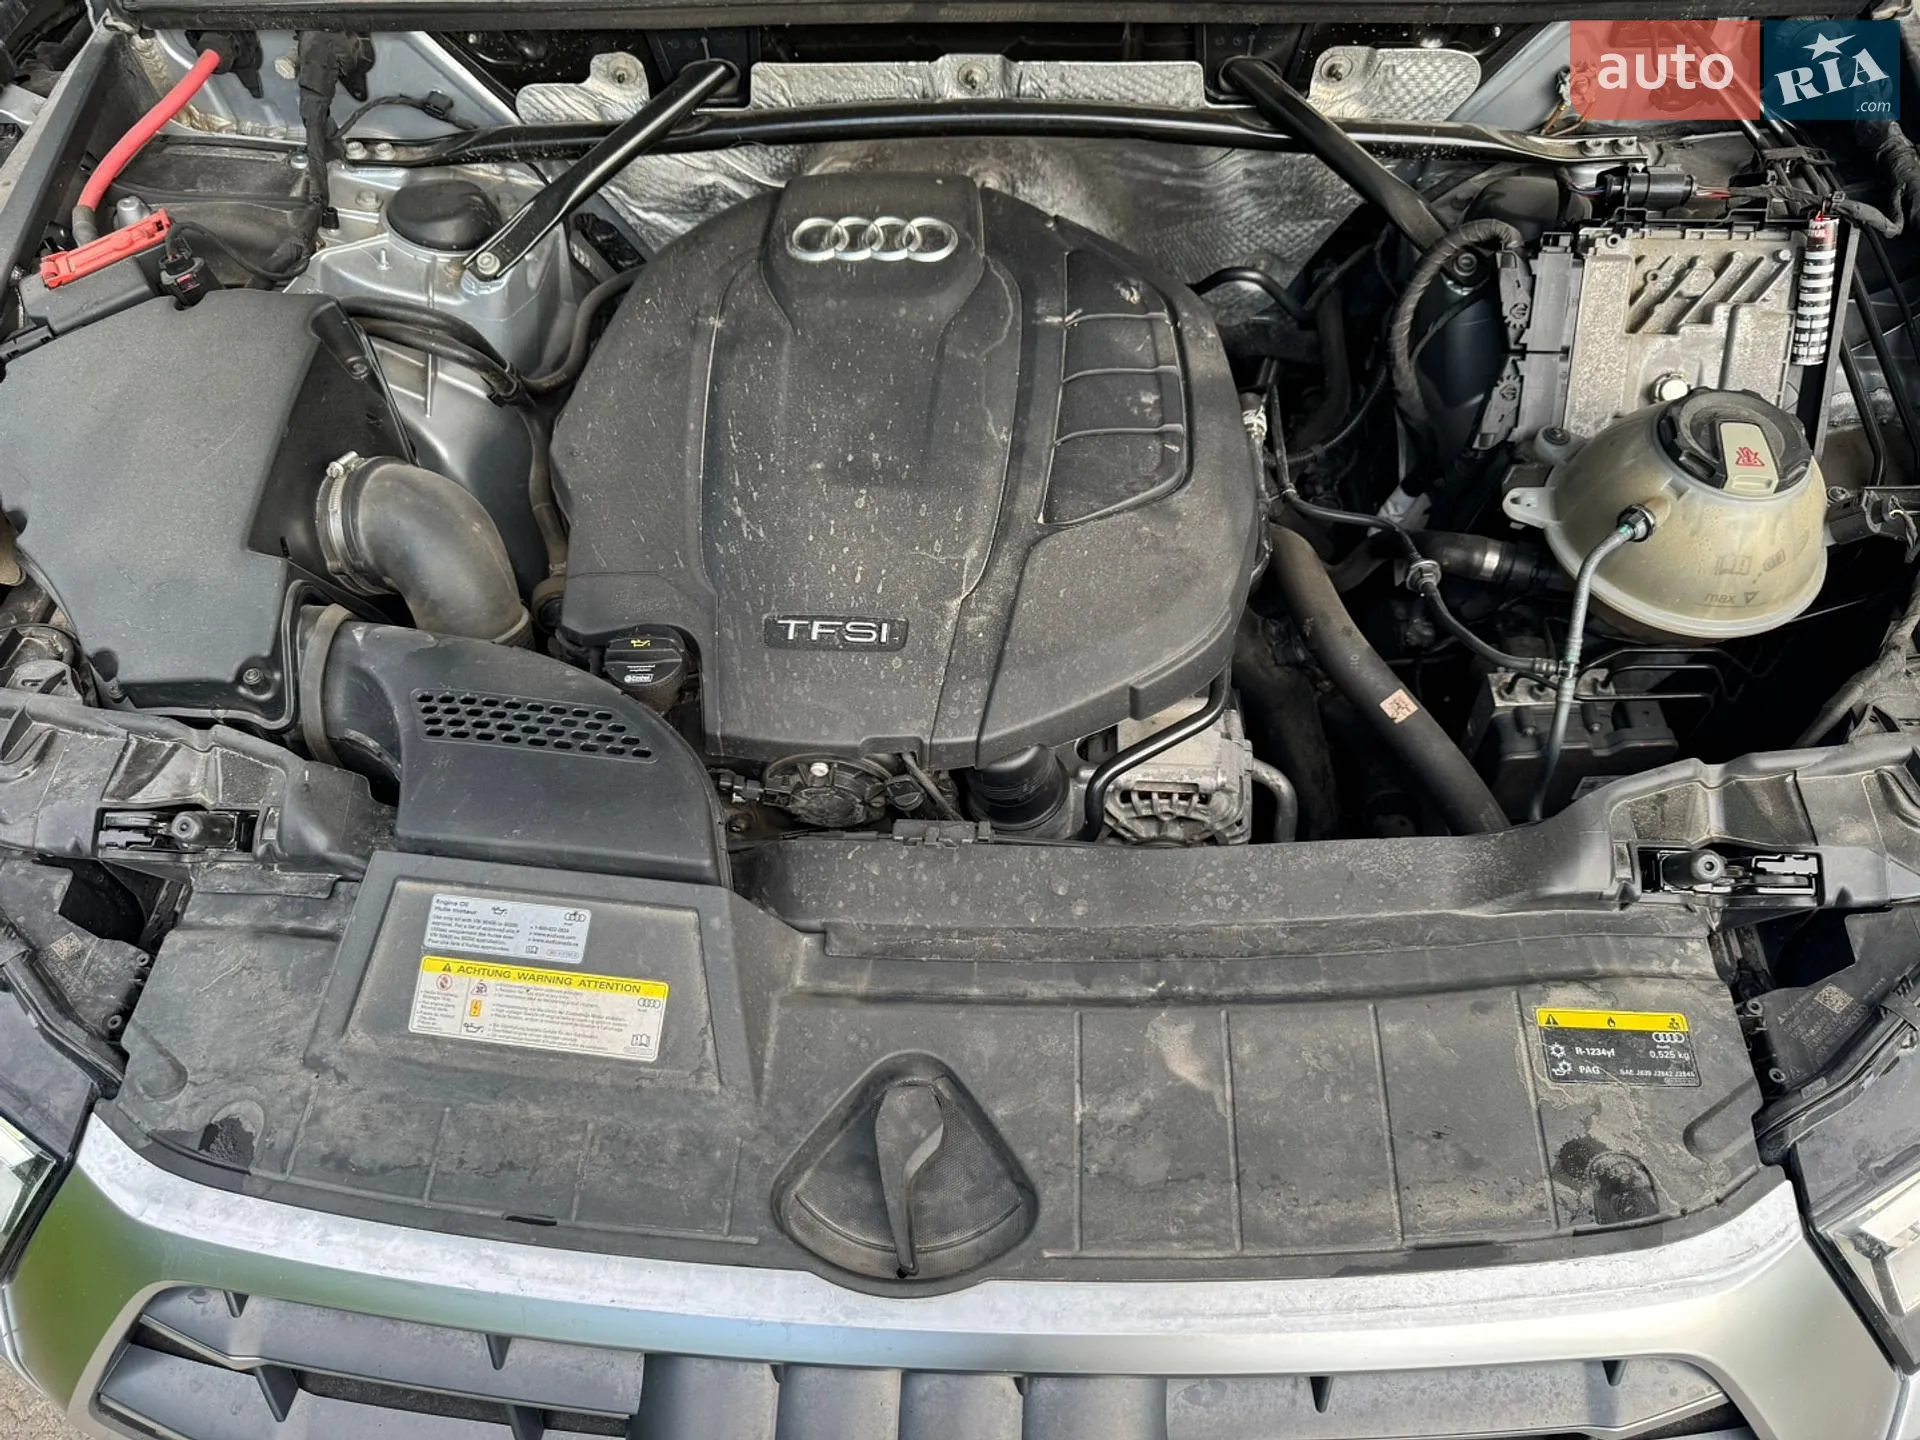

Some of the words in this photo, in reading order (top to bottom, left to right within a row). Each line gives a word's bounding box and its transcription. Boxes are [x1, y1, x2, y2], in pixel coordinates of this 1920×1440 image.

[1704, 592, 1737, 604] max
[777, 619, 889, 643] TFSI
[457, 965, 512, 979] ACHTUNG
[517, 972, 572, 986] WARNING
[577, 979, 642, 993] ATTENTION
[1575, 1046, 1616, 1058] R-1234yf
[1677, 1050, 1690, 1061] kg
[1579, 1065, 1600, 1075] PAG
